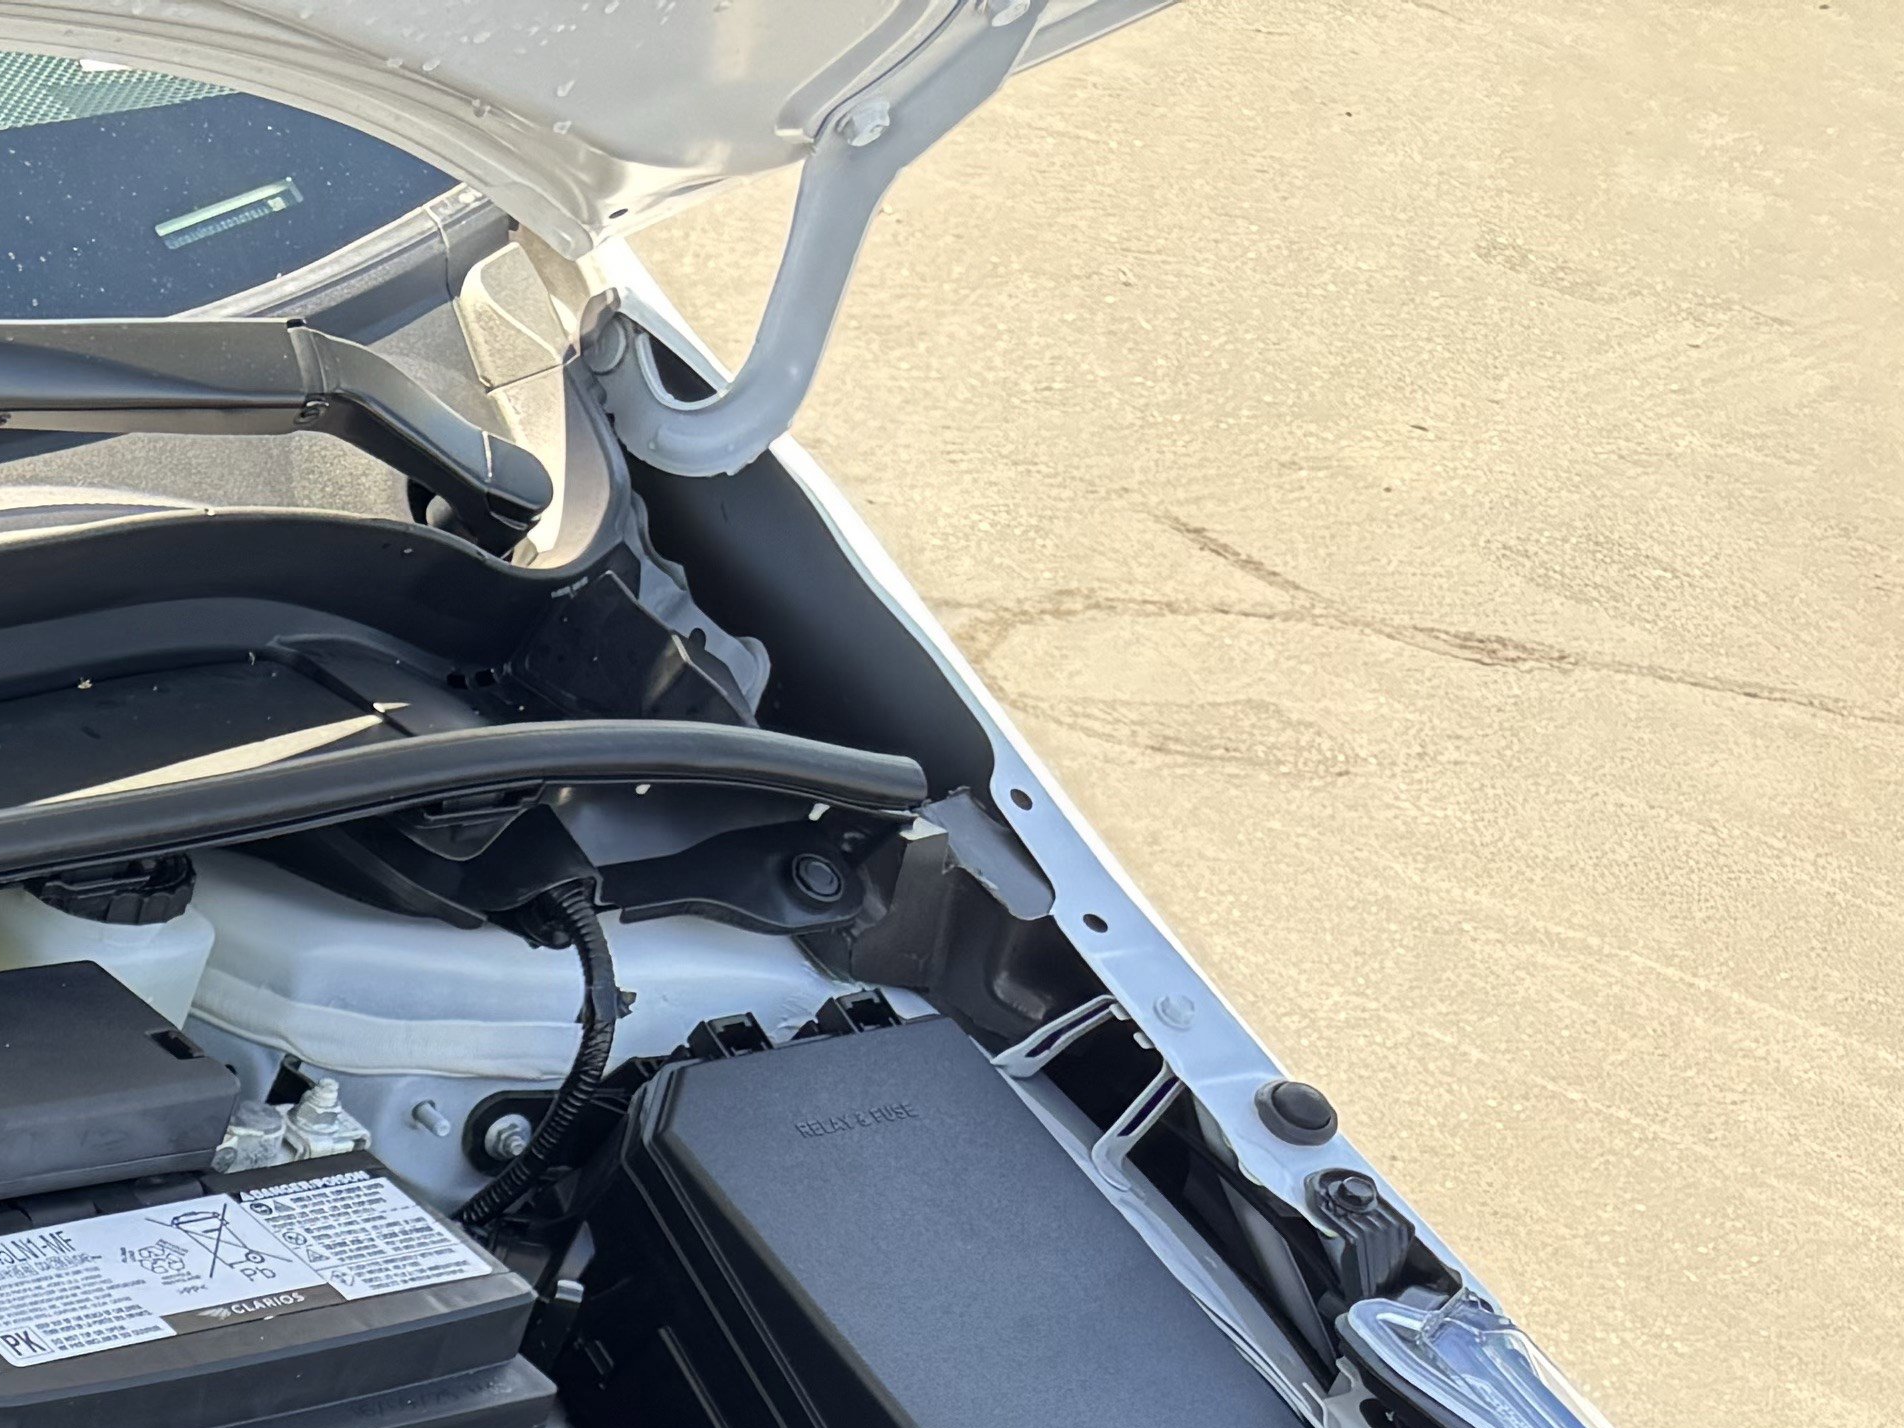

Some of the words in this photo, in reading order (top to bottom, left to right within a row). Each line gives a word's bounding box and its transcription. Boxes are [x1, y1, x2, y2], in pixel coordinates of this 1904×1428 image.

[795, 1113, 856, 1139] RELAY
[874, 1101, 919, 1124] FUSE
[237, 1263, 279, 1283] Pb
[229, 1291, 306, 1316] CLARIOS
